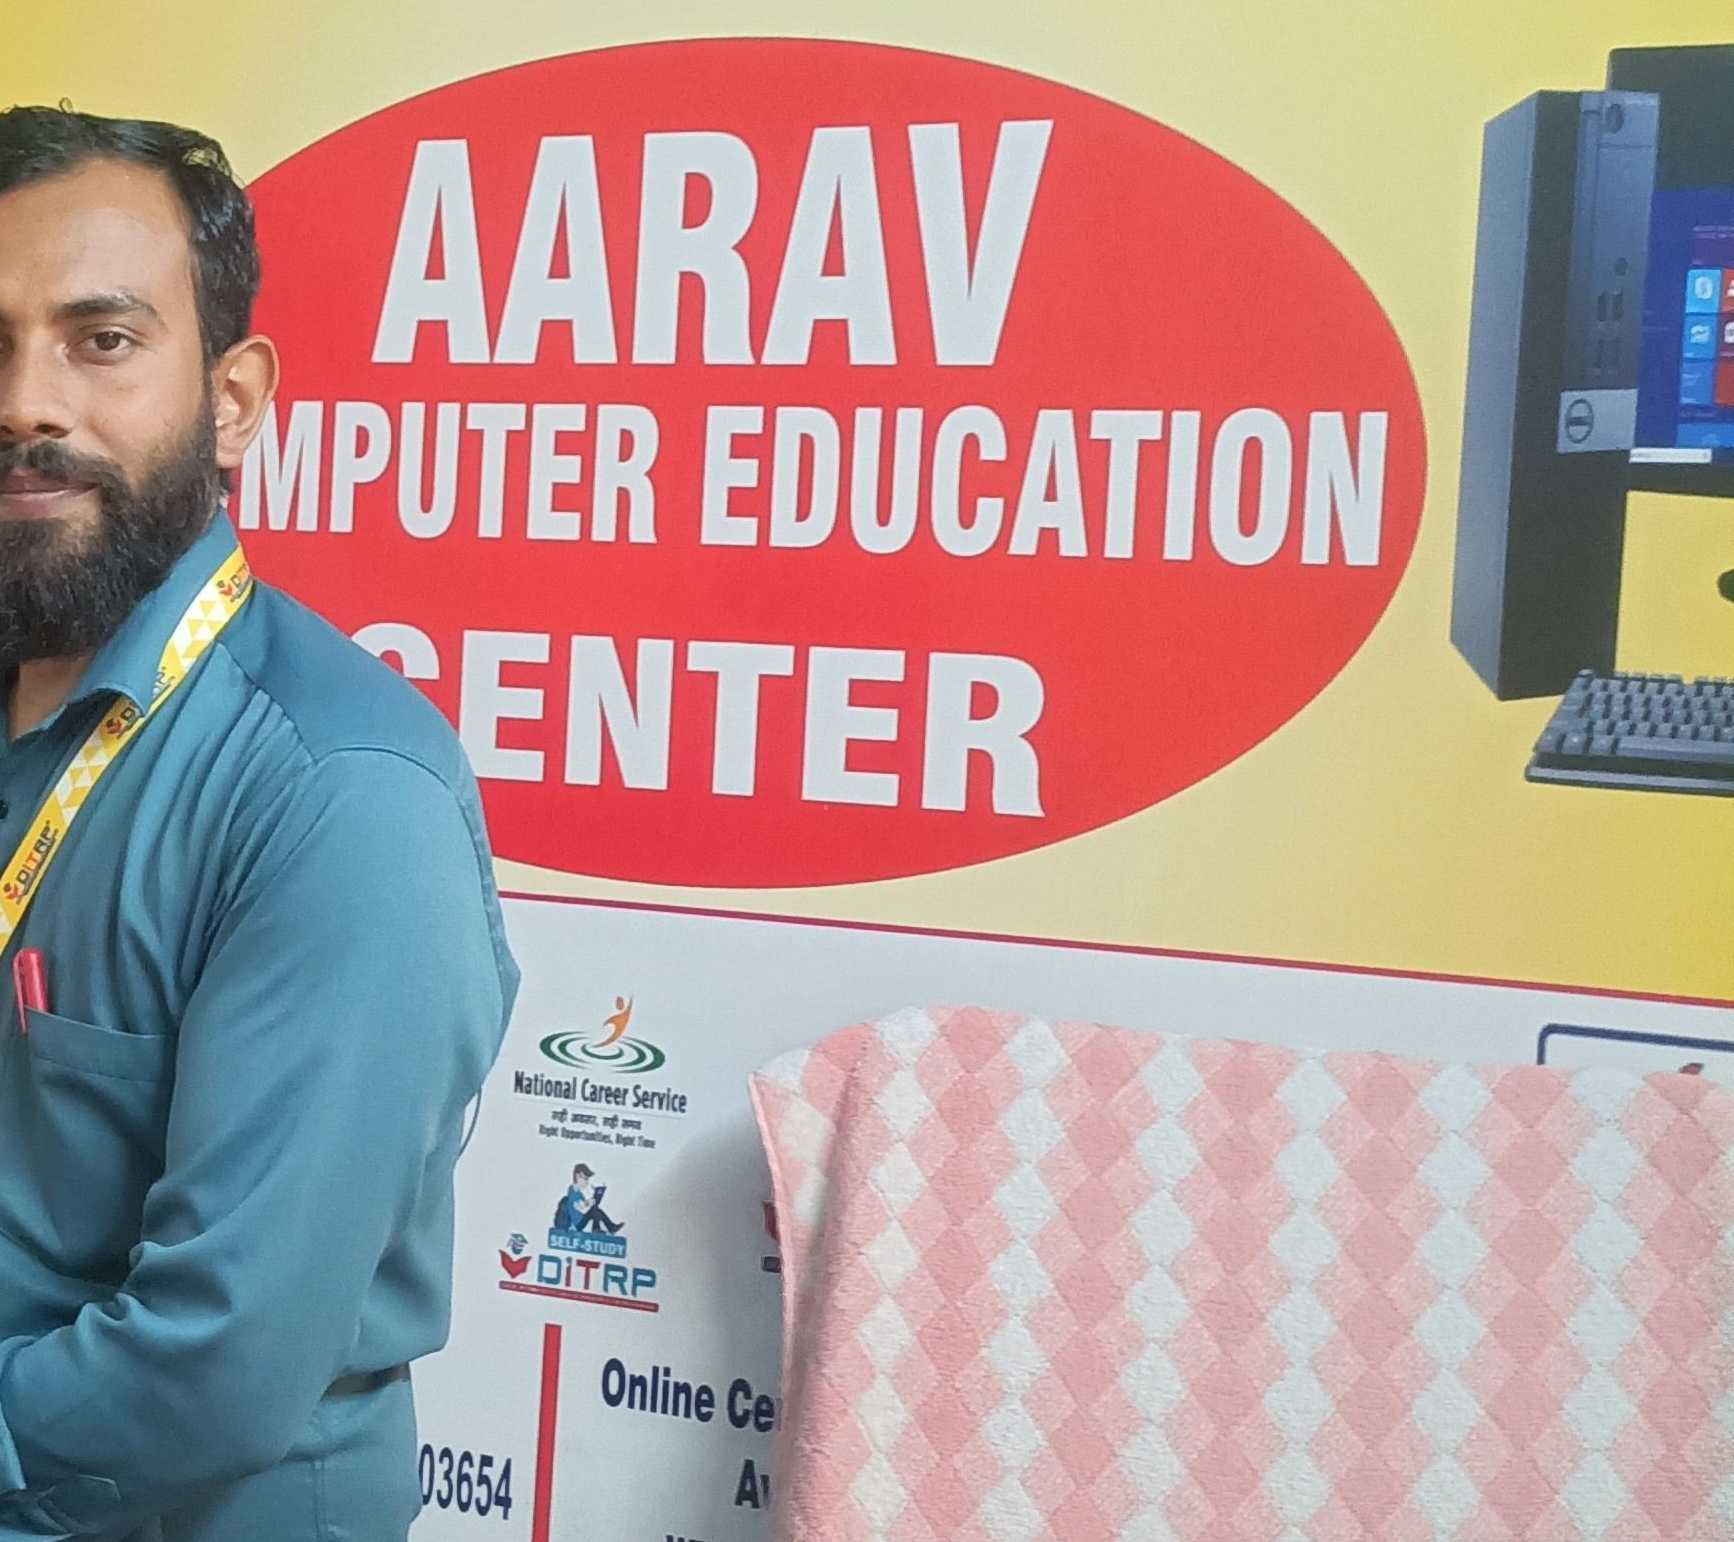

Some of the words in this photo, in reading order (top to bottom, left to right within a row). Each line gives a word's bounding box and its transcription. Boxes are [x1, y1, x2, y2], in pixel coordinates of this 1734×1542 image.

[372, 119, 1055, 367] AARAV
[699, 403, 1388, 570] EDUCATION
[514, 1070, 576, 1100] National
[581, 1078, 629, 1106] Career
[632, 1084, 687, 1113] Service
[549, 1233, 625, 1255] SELF-STUDY
[601, 1357, 714, 1423] Online
